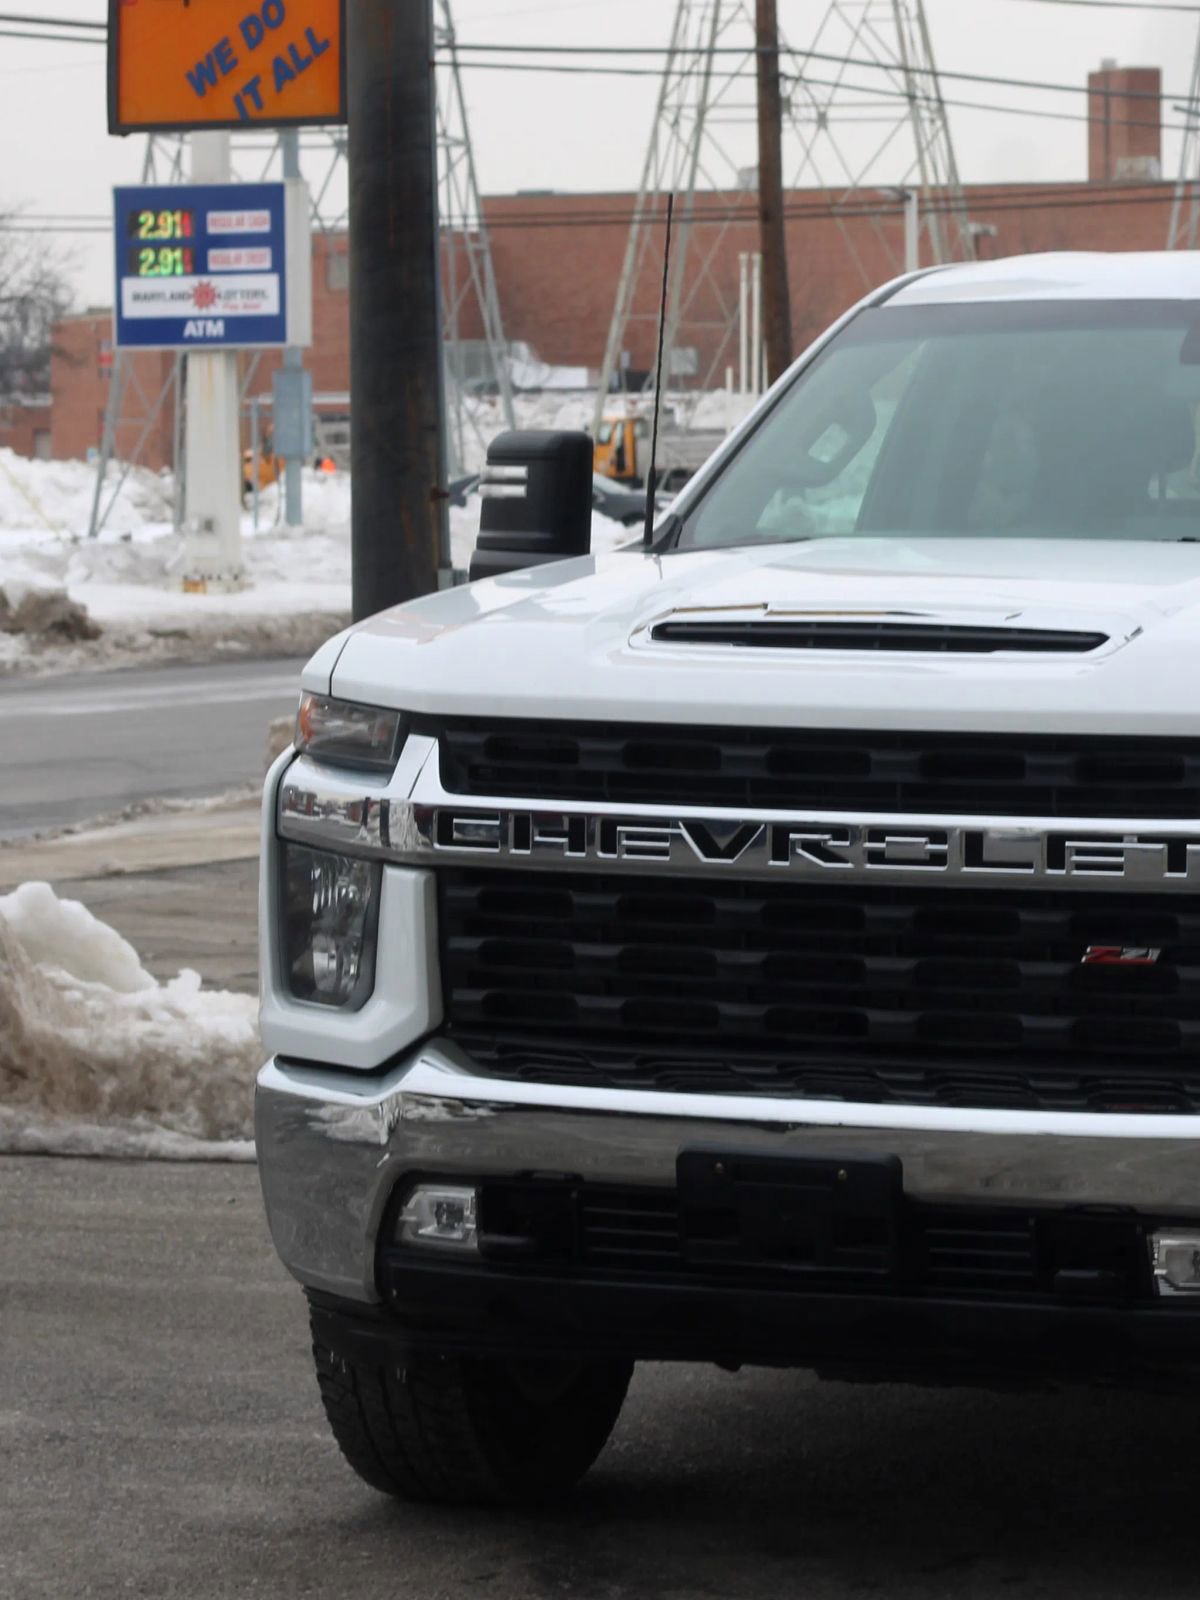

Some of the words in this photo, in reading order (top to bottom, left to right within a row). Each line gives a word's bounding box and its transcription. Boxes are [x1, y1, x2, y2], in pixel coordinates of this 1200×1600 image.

[185, 36, 239, 97] WE
[239, 0, 285, 51] DO
[232, 75, 265, 121] IT
[271, 26, 331, 93] ALL
[183, 319, 225, 338] ATM
